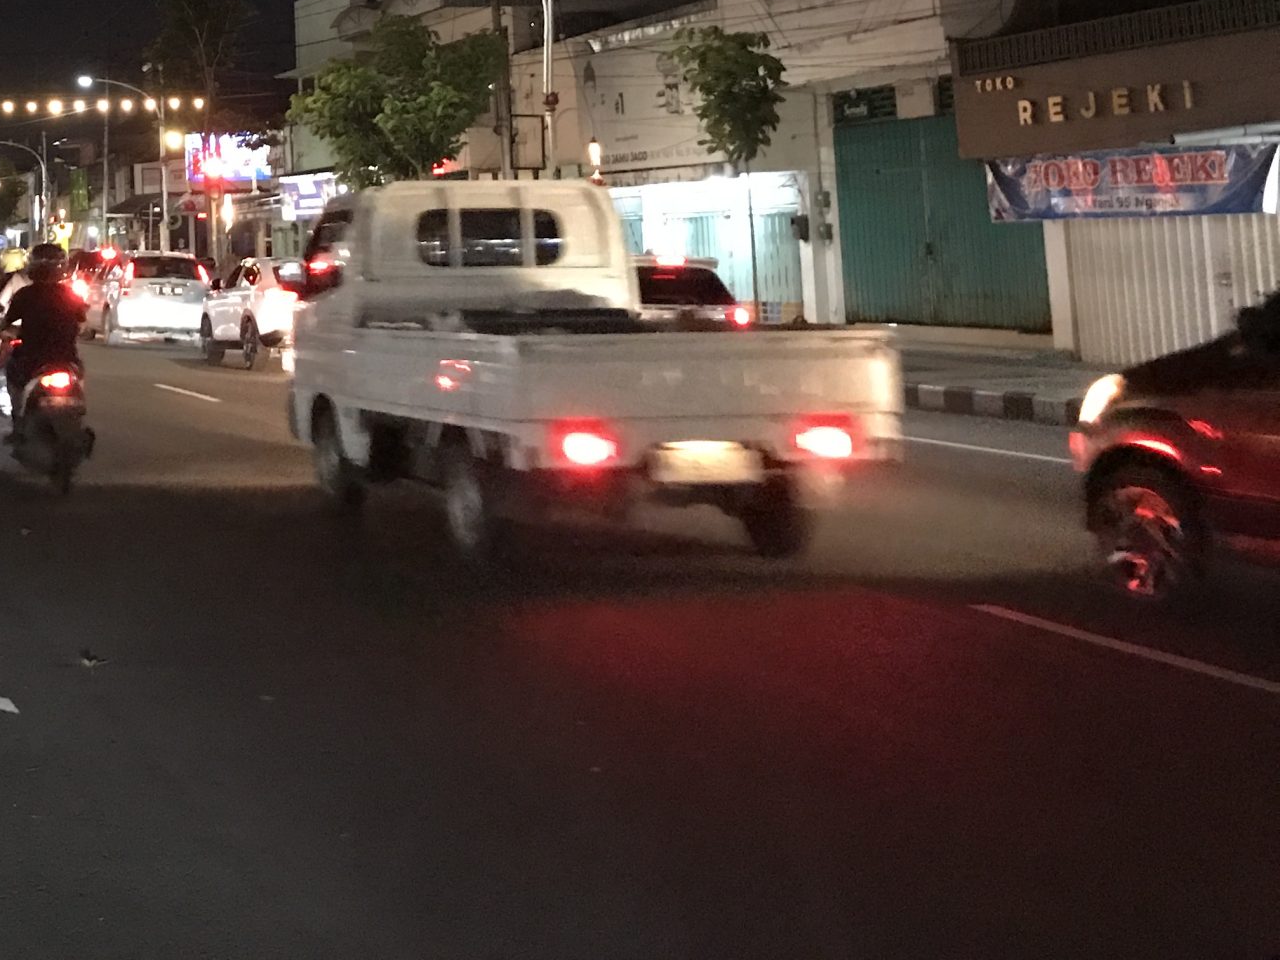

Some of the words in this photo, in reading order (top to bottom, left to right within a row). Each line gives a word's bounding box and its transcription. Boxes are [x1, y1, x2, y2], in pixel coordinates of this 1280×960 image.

[975, 76, 1015, 93] TOKO
[1018, 80, 1194, 126] REJEKI
[1107, 151, 1228, 187] REJEKI
